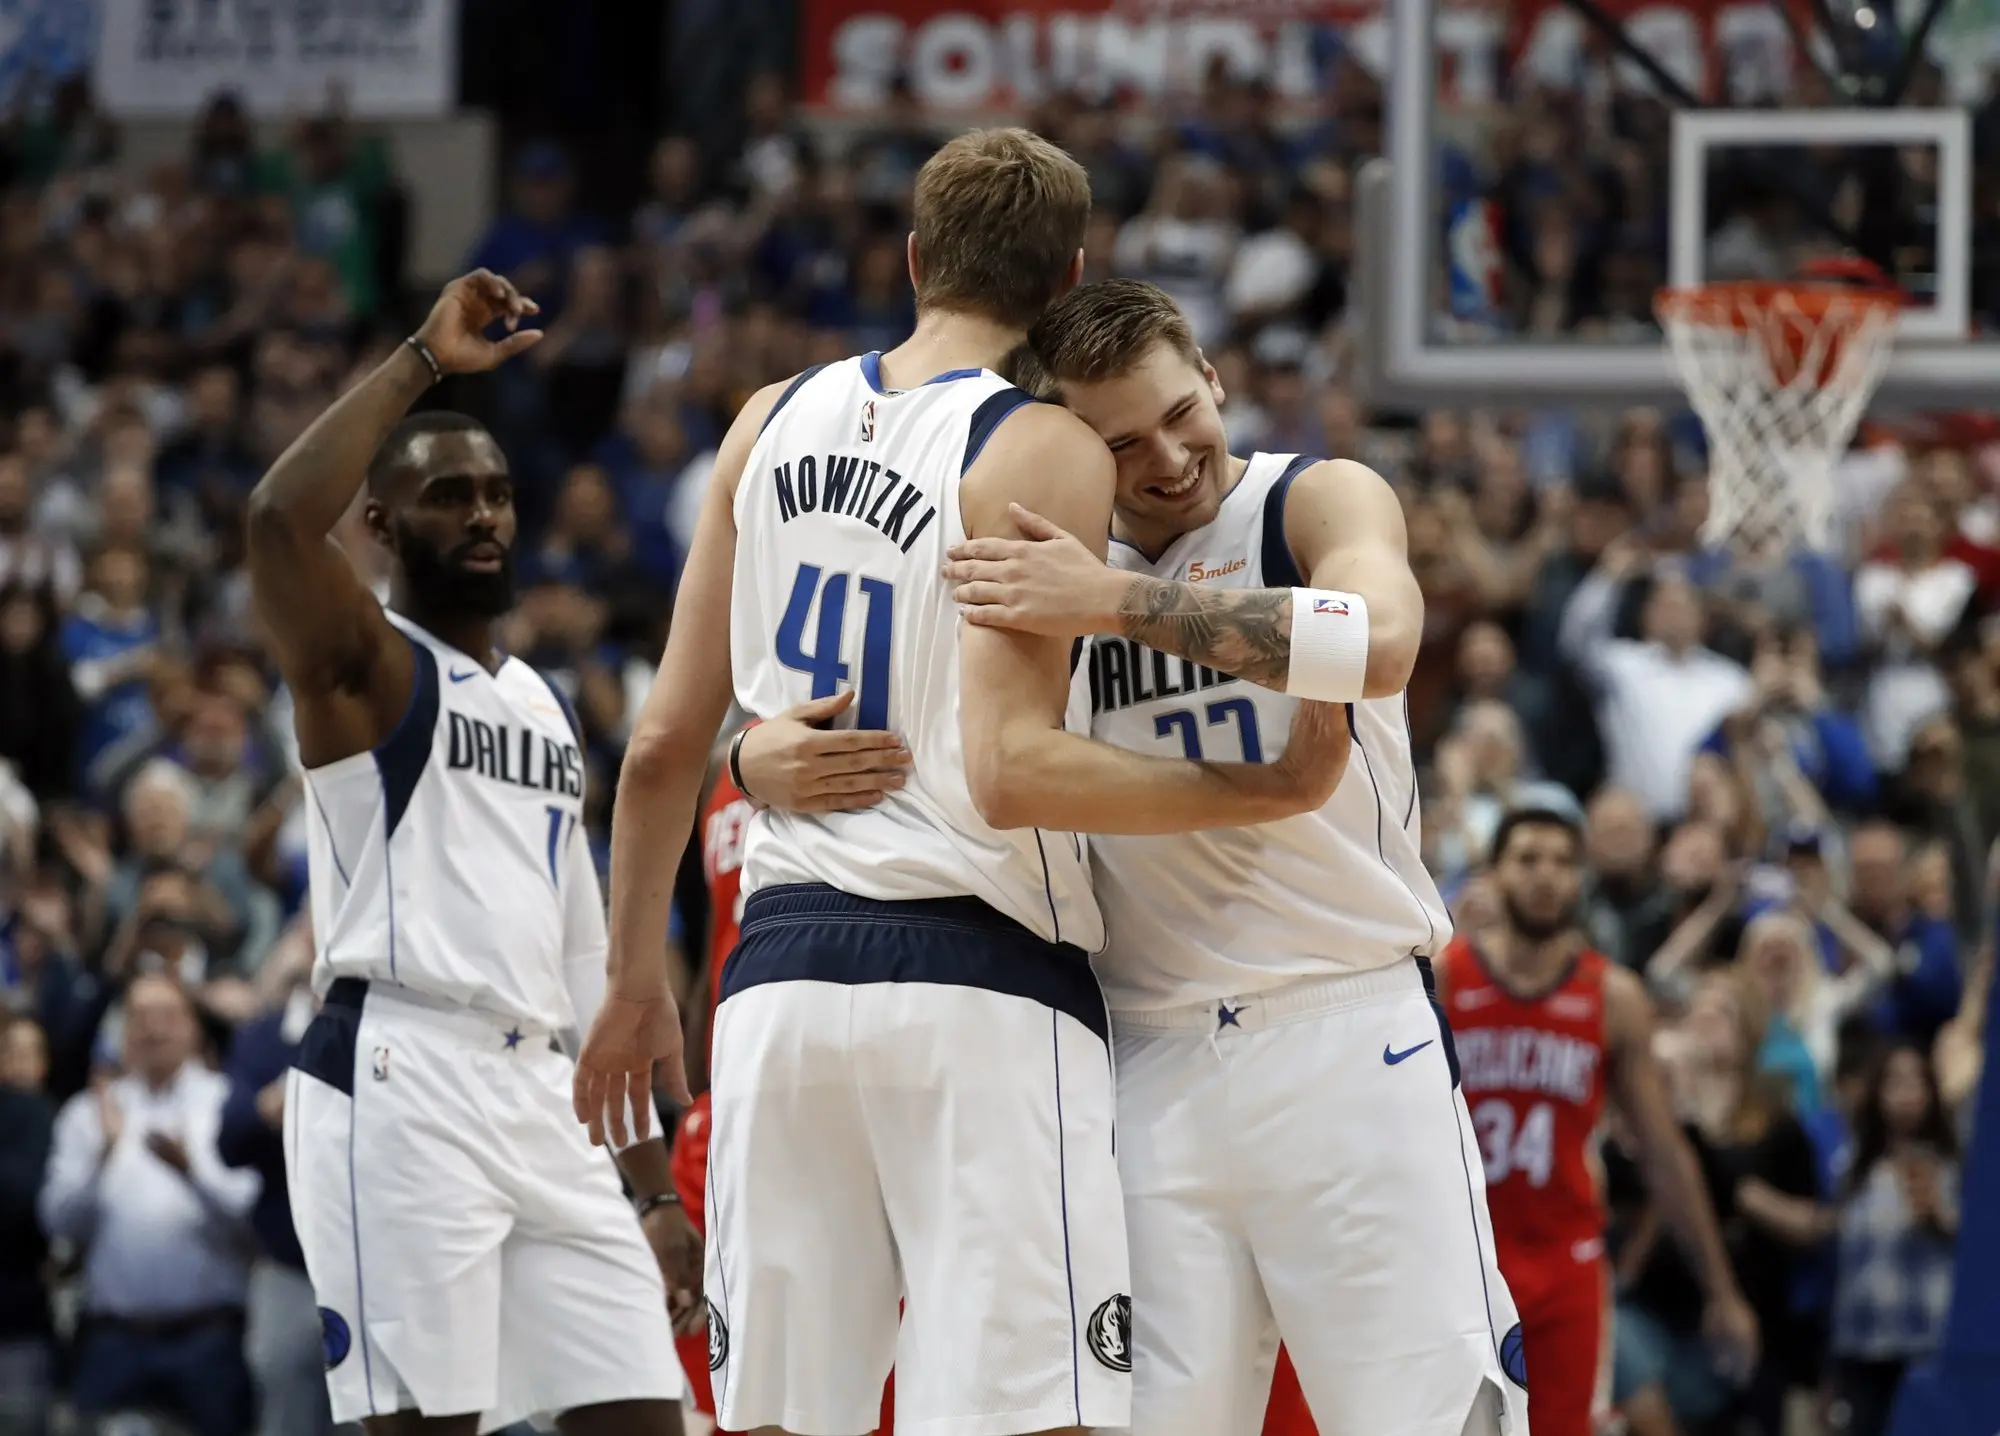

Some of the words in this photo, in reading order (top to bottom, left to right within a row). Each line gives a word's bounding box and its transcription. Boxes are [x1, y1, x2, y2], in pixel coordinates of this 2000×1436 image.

[774, 454, 937, 555] NOWITZKI
[1188, 557, 1248, 582] 5miles
[773, 561, 895, 732] 41
[447, 709, 583, 799] DALLAS
[1153, 696, 1264, 764] 77
[1473, 1096, 1557, 1189] 34
